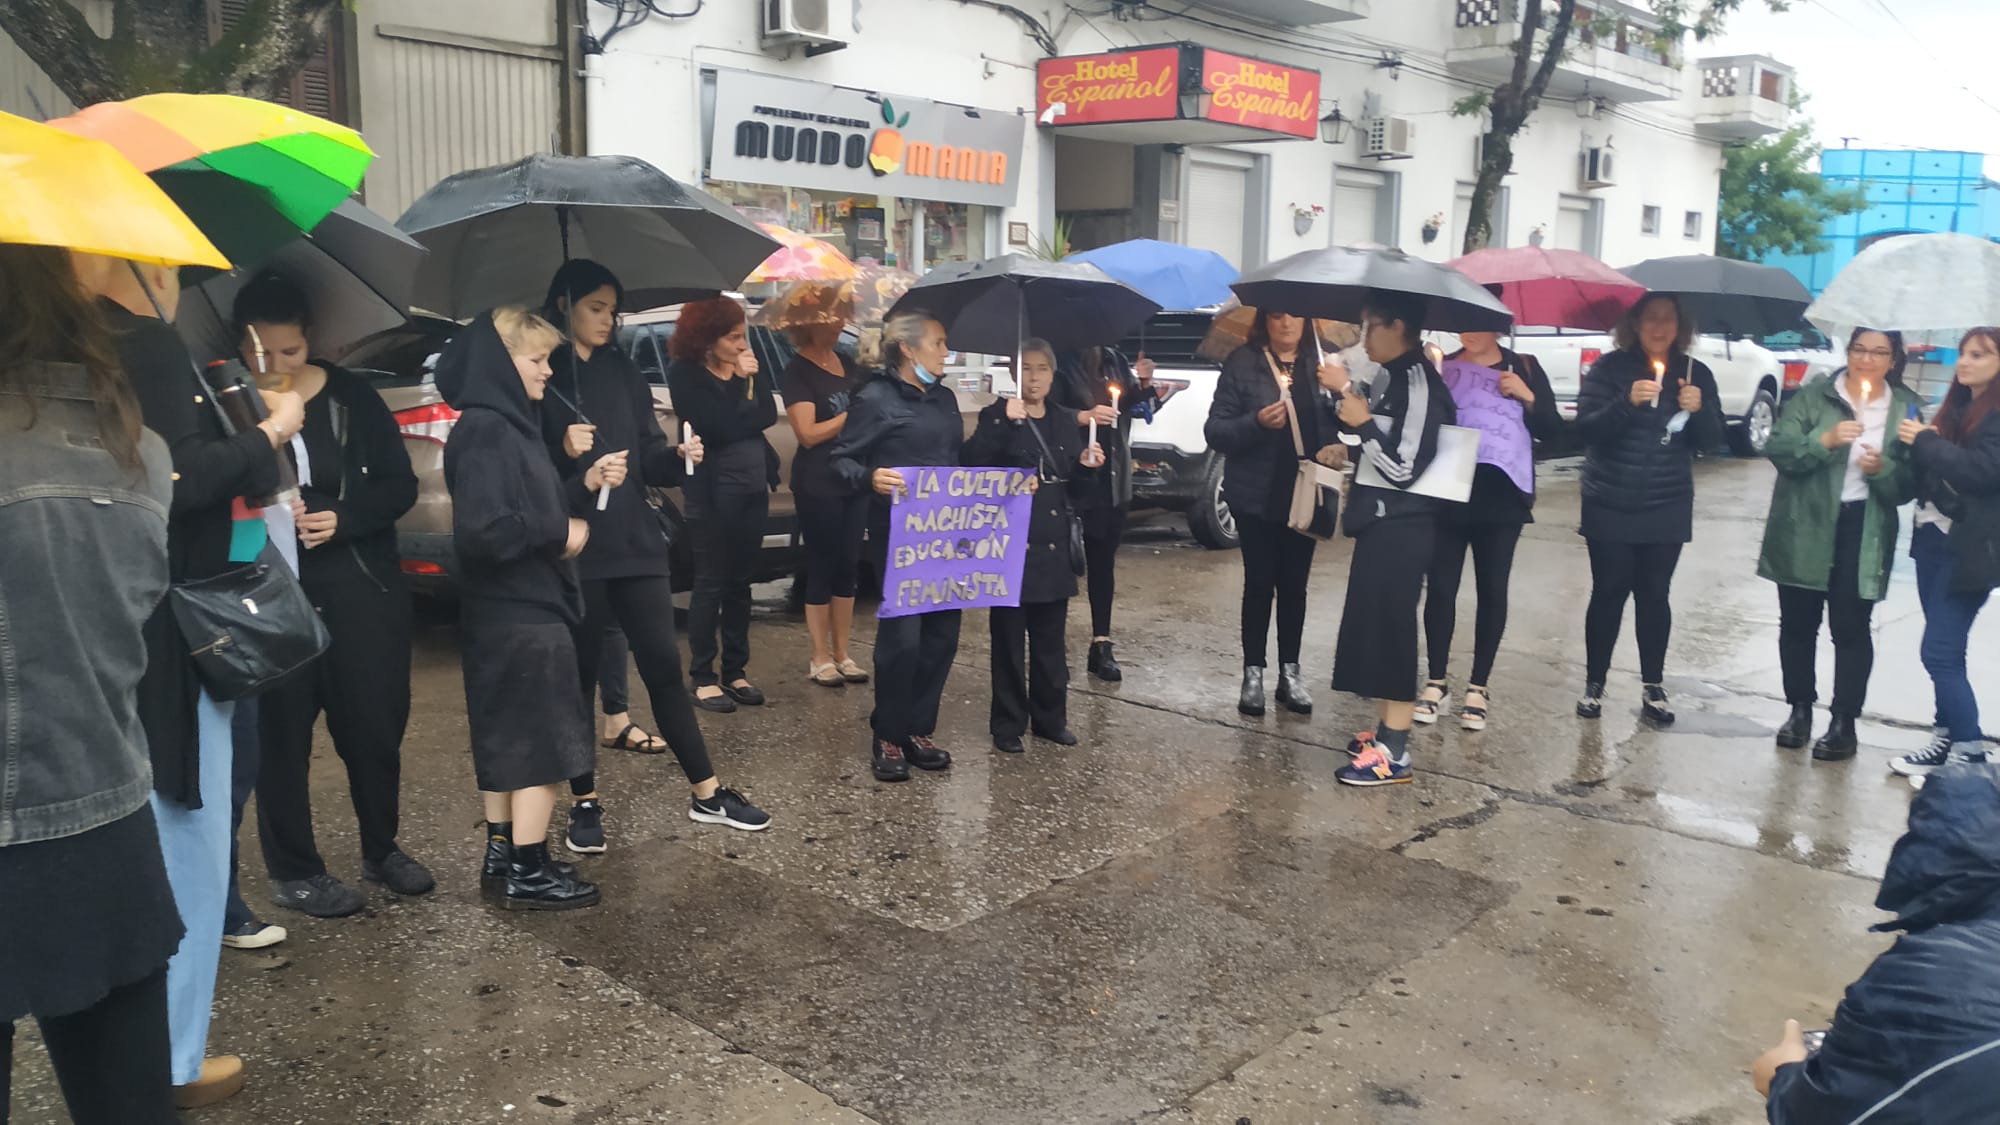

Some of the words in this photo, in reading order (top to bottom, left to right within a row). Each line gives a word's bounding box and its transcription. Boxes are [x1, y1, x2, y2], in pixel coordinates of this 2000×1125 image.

[1075, 56, 1138, 82] Hotel
[1239, 62, 1290, 94] Hotel
[1042, 65, 1172, 113] Español
[1210, 71, 1313, 122] Español
[916, 469, 940, 499] LA
[948, 470, 1034, 498] CULTURA
[905, 502, 1008, 533] MACHISTA
[896, 571, 1008, 608] FEMINISTA
